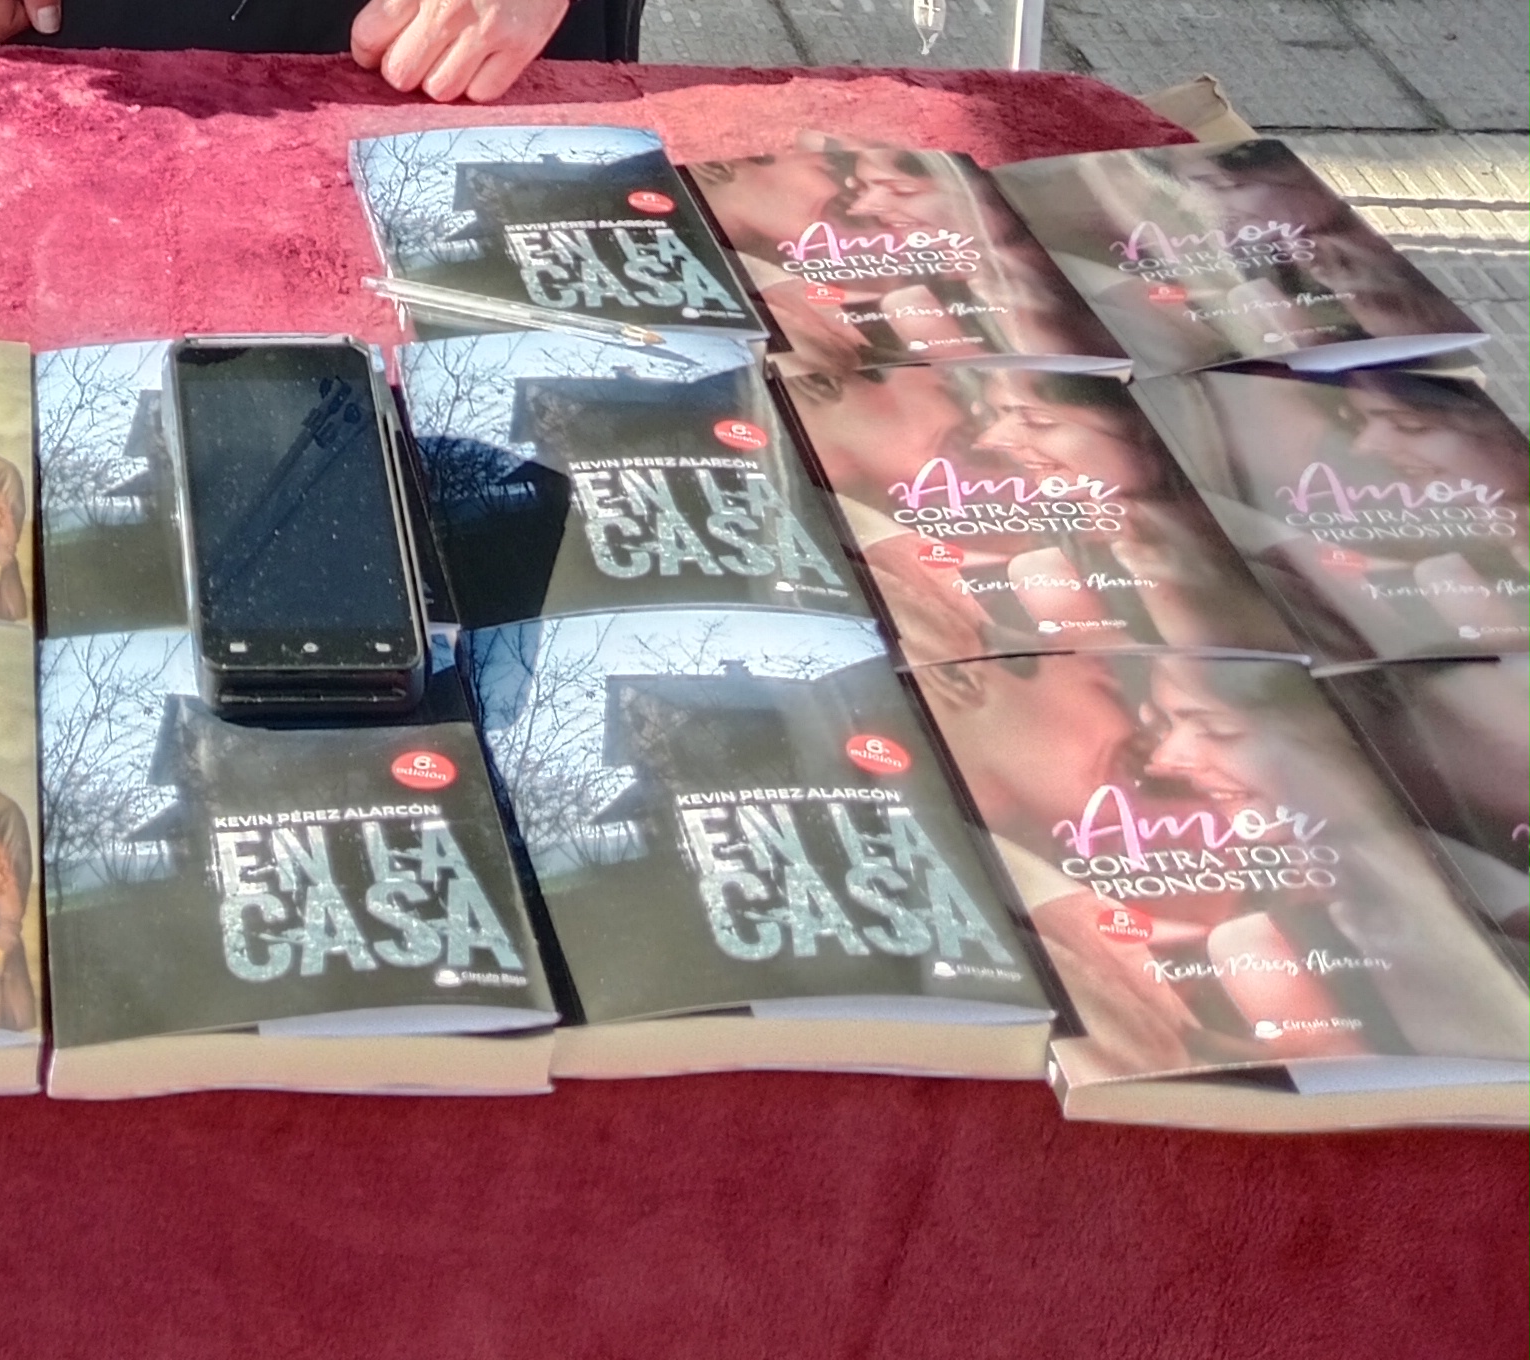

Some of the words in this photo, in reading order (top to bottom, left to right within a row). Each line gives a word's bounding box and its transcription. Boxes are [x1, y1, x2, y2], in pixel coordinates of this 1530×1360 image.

[506, 229, 587, 265] EN
[614, 228, 686, 263] LA
[777, 221, 974, 261] Amor
[1109, 220, 1306, 261] Amor
[1118, 248, 1229, 274] CONTRA
[1232, 237, 1315, 255] TODO
[783, 251, 900, 274] CONTRA
[902, 249, 981, 263] TODO
[803, 261, 977, 283] PRONÓSTICO
[1140, 251, 1314, 283] PRONÓSTICO
[520, 259, 742, 312] CASA
[569, 458, 620, 471] KEVIN
[622, 456, 676, 468] PÉREZ
[679, 457, 758, 470] ALARCÓN
[572, 469, 677, 520] EN
[698, 467, 785, 517] LA
[888, 457, 1119, 512] Amor
[1275, 461, 1505, 521] Amor
[893, 502, 1030, 525] CONTRA
[1031, 501, 1126, 517] TODO
[916, 515, 1122, 540] PRONÓSTICO
[1285, 508, 1420, 527] CONTRA
[1422, 506, 1516, 522] TODO
[584, 513, 843, 586] CASA
[1310, 522, 1516, 542] PRONÓSTICO
[677, 791, 735, 806] KEVIN
[739, 787, 804, 802] PÉREZ
[807, 787, 901, 802] ALARCÓN
[215, 814, 272, 828] KEVIN
[277, 808, 340, 823] PÉREZ
[343, 804, 439, 819] ALARCÓN
[1053, 784, 1327, 867] Amor
[680, 804, 810, 876] EN
[829, 802, 948, 870] LA
[210, 825, 331, 896] EN
[361, 820, 472, 881] LA
[1061, 852, 1225, 882] CONTRA
[1232, 844, 1340, 868] TODO
[1090, 867, 1336, 902] PRONÓSTICO
[220, 879, 524, 982] CASA
[699, 864, 1015, 963] CASA
